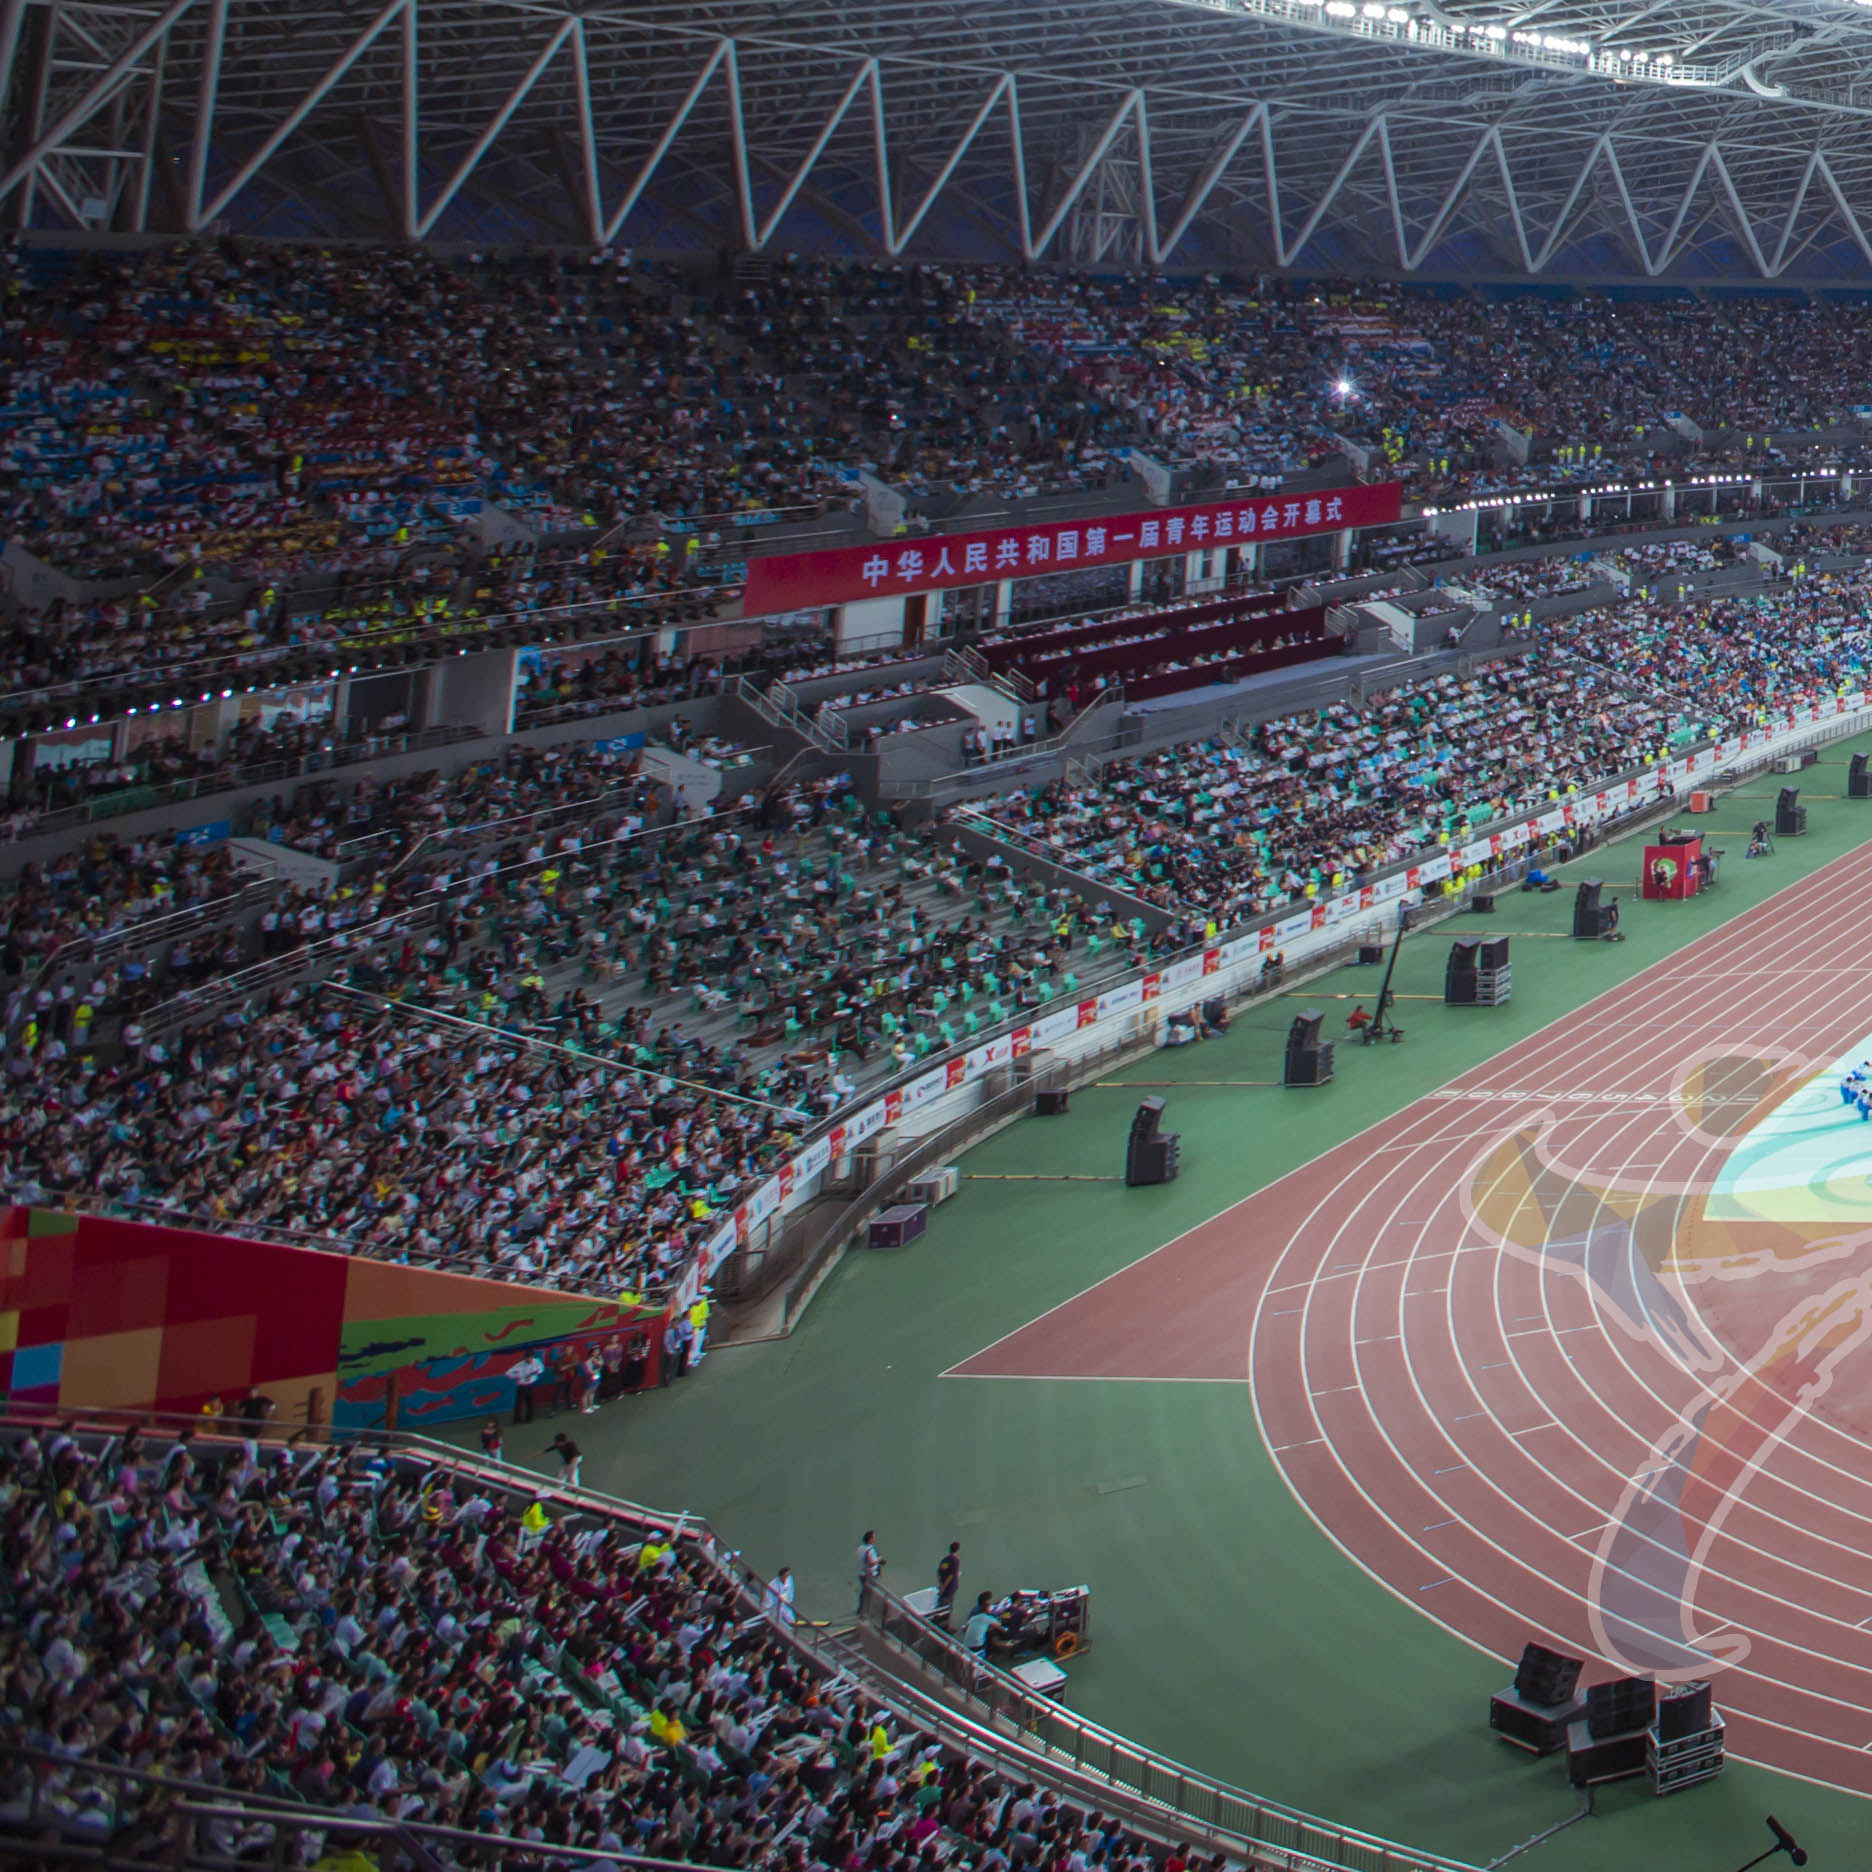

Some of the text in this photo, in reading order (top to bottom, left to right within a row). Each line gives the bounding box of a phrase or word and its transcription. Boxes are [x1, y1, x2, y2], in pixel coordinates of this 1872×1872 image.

[862, 496, 1343, 588] 中华人民共和国第一届青年运动会开幕式
